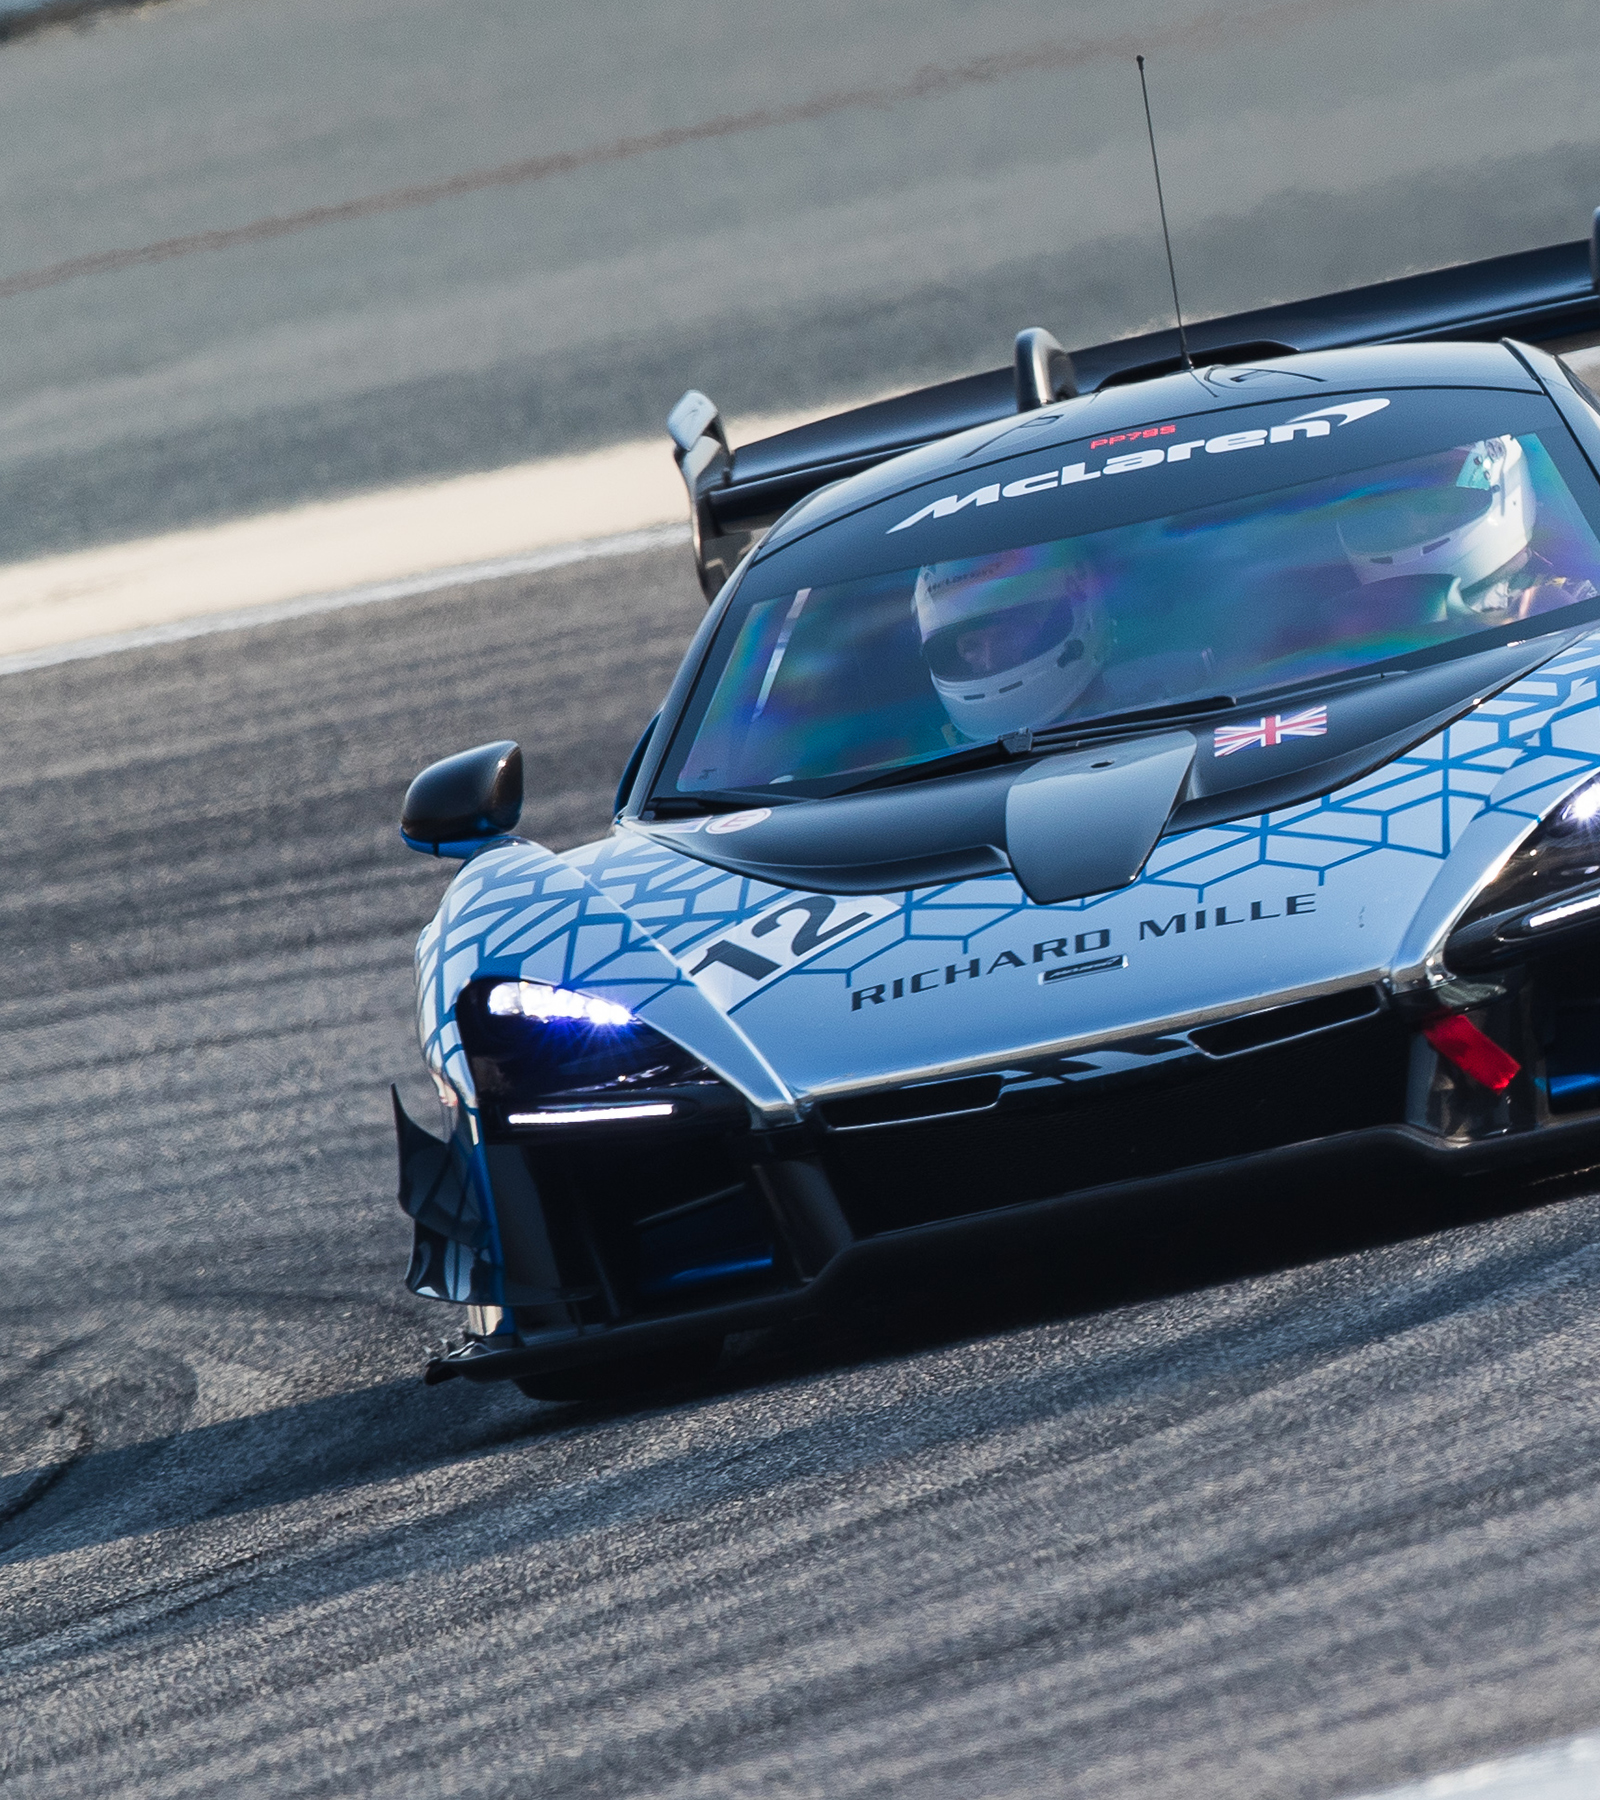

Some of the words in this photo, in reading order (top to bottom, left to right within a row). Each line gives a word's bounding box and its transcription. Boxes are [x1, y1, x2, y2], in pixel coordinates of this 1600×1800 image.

[886, 398, 1391, 535] McLaren
[689, 895, 874, 982] 12
[851, 928, 1110, 1012] RICHARD
[1139, 893, 1317, 941] MILLE
